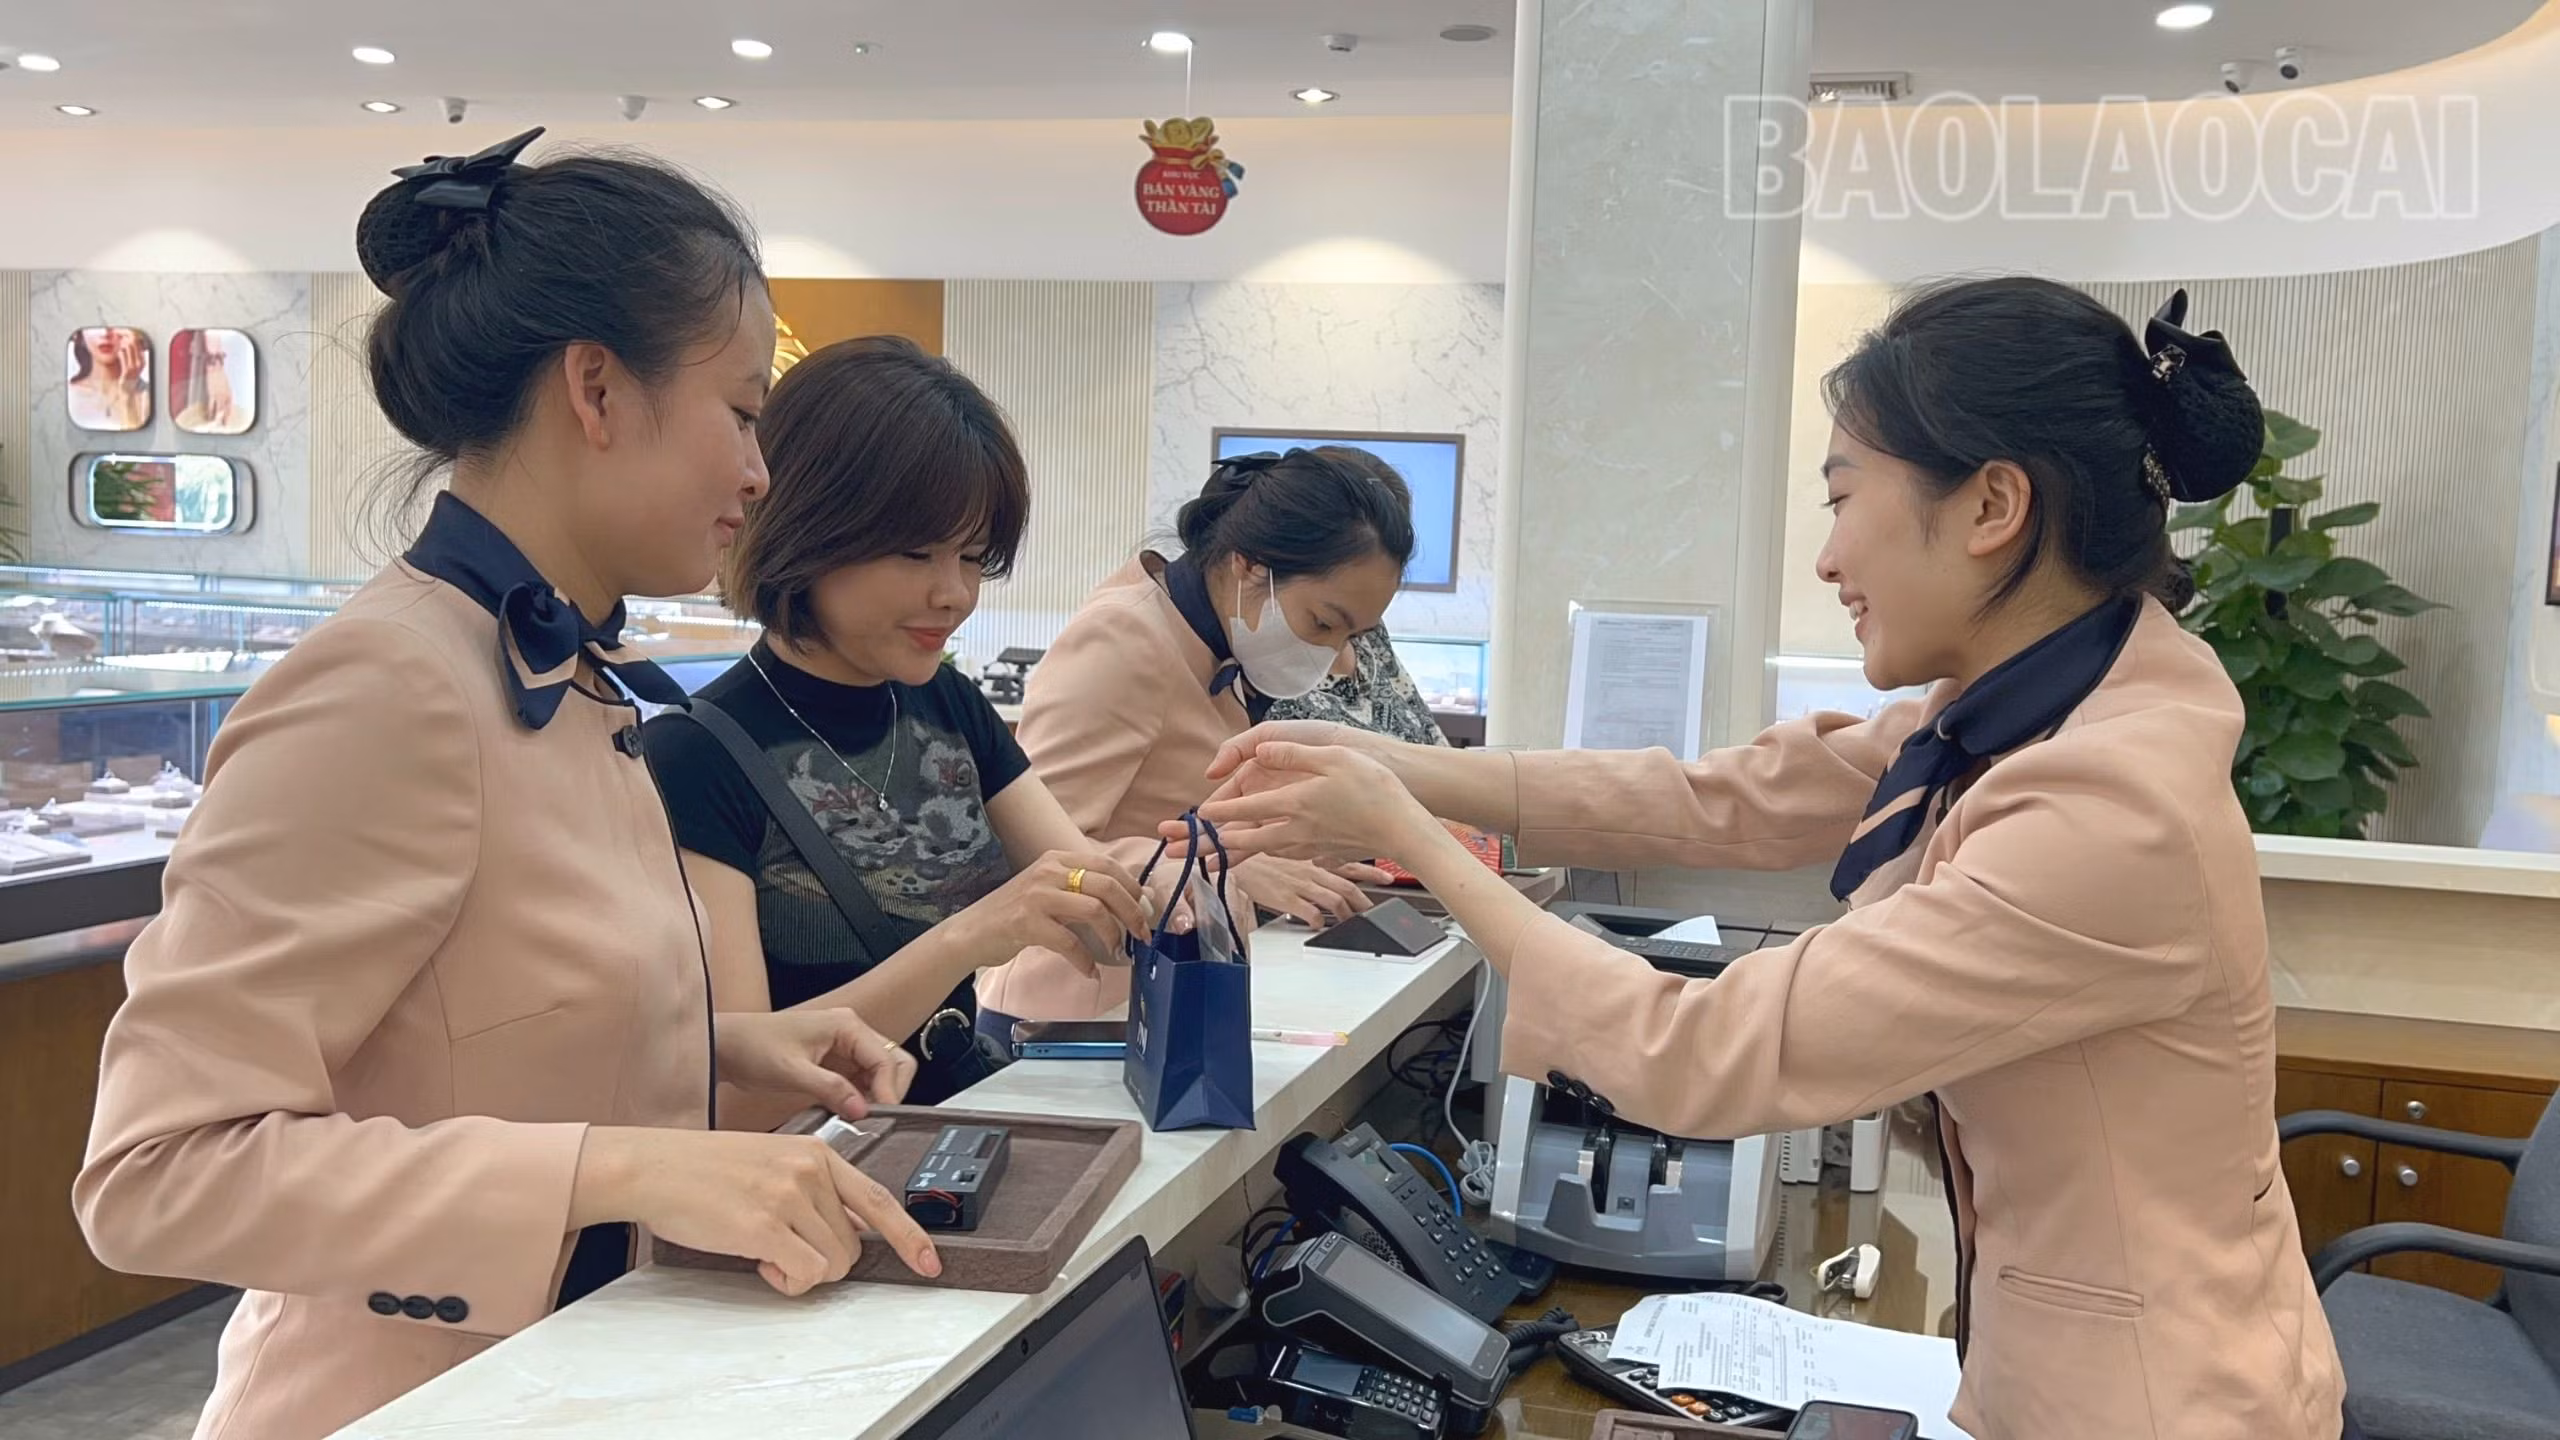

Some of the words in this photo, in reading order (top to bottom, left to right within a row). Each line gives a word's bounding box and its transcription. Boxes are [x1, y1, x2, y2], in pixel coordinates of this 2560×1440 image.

[1143, 182, 1176, 196] BÁN
[1178, 183, 1220, 198] VÀNG
[1145, 199, 1189, 213] THẦN
[1190, 200, 1217, 215] TÀI
